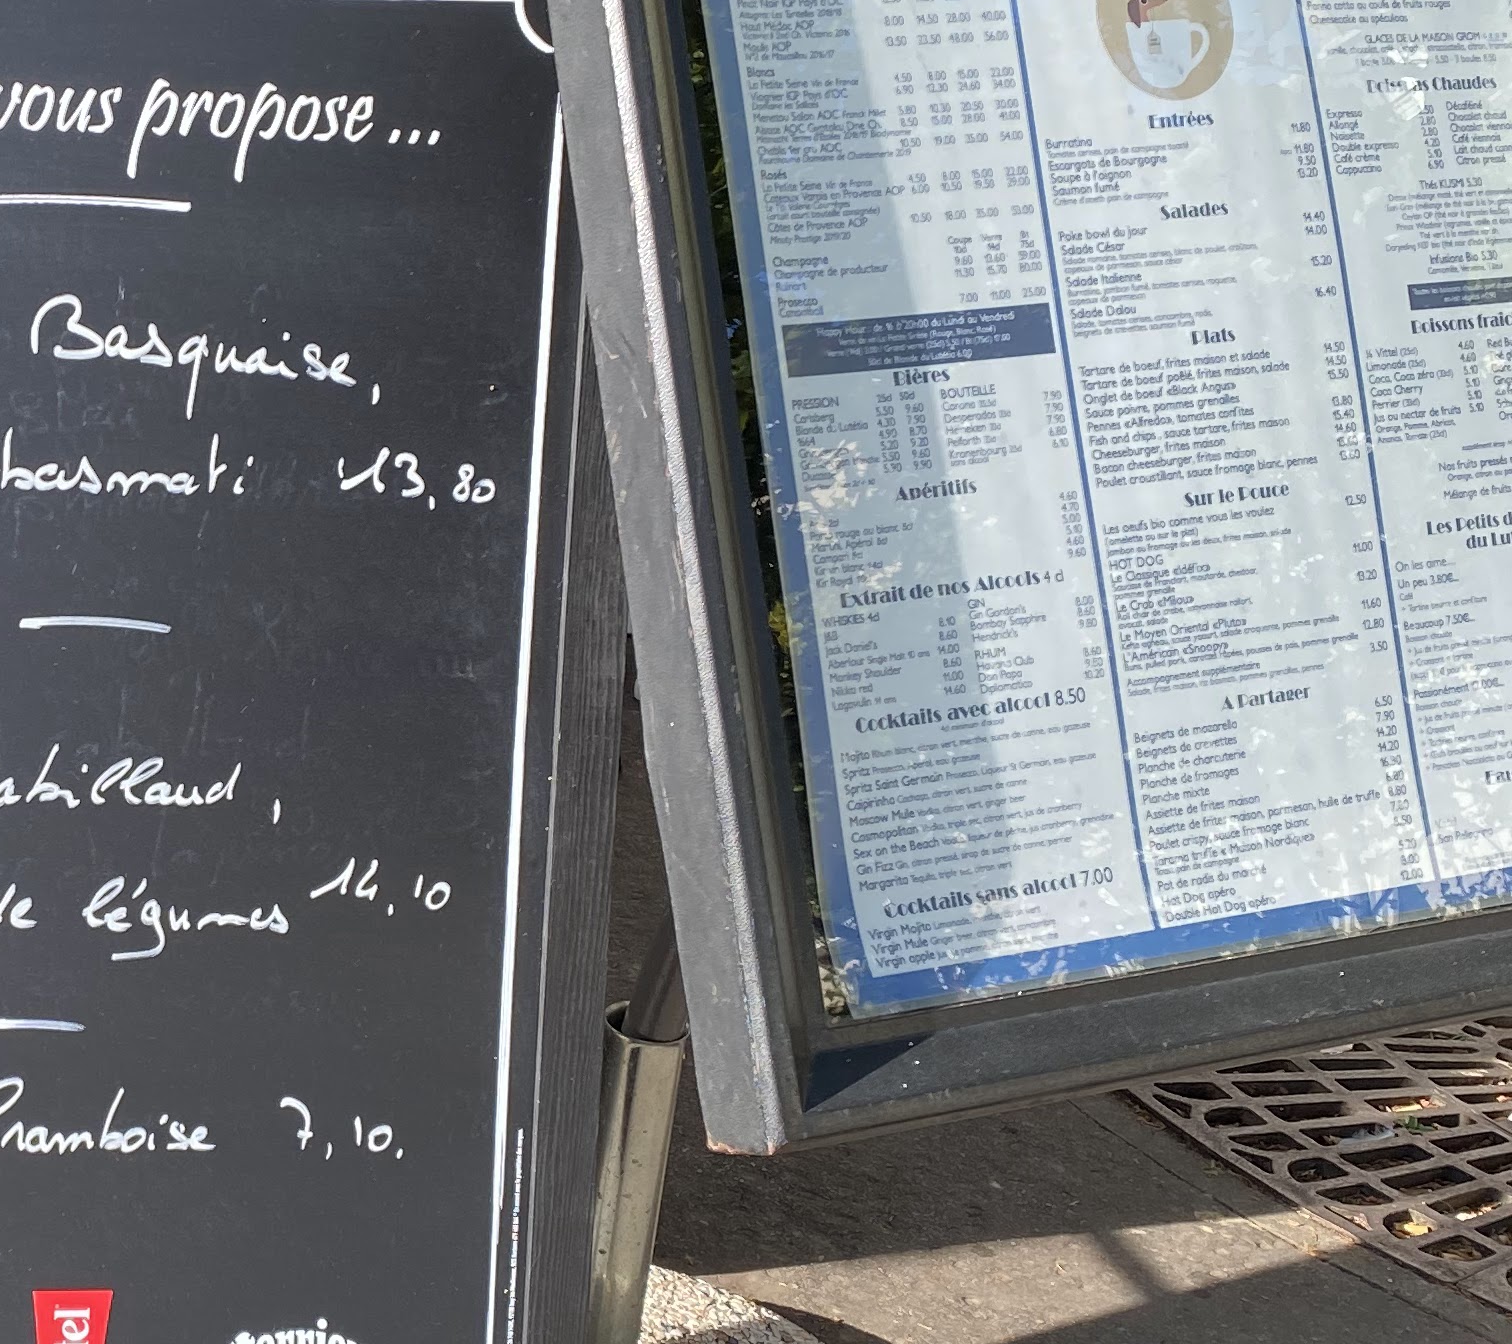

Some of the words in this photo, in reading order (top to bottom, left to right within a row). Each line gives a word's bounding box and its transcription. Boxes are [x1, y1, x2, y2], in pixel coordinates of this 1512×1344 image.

[1431, 74, 1496, 92] Chaudes
[1147, 109, 1214, 129] Entrées
[1047, 158, 1096, 172] Escargots
[1098, 157, 1110, 168] de
[1113, 153, 1167, 169] Bourgogne
[1050, 172, 1081, 184] Soupe
[1052, 184, 1092, 196] Saumon
[1159, 201, 1228, 220] Salades
[1085, 227, 1110, 239] bowl
[1126, 225, 1148, 239] jour
[1060, 243, 1093, 256] Salade
[1095, 240, 1124, 253] César
[1065, 275, 1098, 288] Salade
[1069, 306, 1103, 319] Salade
[1411, 314, 1474, 335] Boissons
[1477, 311, 1512, 328] fraic
[1190, 326, 1235, 345] Plats
[1078, 363, 1115, 377] Tartare
[1118, 362, 1131, 373] de
[1164, 356, 1190, 369] frites
[1193, 353, 1226, 365] maison
[1229, 352, 1239, 362] et
[1241, 348, 1270, 361] salade
[892, 365, 950, 386] Bières
[940, 383, 996, 400] BOUTEILLE
[1083, 391, 1118, 406] Onglet
[1120, 390, 1132, 401] de
[1134, 386, 1163, 400] boeuf
[1394, 382, 1423, 396] Cherry
[1164, 439, 1189, 453] frites
[1192, 436, 1225, 450] maison
[2, 428, 254, 497] basmati
[339, 447, 496, 510] 13,80
[894, 477, 977, 502] Apéritifs
[1184, 489, 1214, 507] Sur
[1218, 487, 1235, 503] le
[1238, 480, 1289, 501] Pouce
[1103, 523, 1119, 535] Les
[1150, 518, 1165, 529] bio
[1169, 514, 1203, 528] comme
[1206, 511, 1228, 523] vous
[1426, 517, 1452, 536] Les
[1454, 511, 1500, 532] Petits
[1465, 532, 1487, 550] du
[1108, 557, 1134, 571] HOT
[1136, 554, 1163, 567] DOG
[839, 585, 905, 609] Extrait
[909, 582, 934, 600] de
[937, 579, 970, 597] nos
[973, 568, 1040, 592] Alcools
[974, 646, 1006, 660] RHUM
[1220, 695, 1234, 711] A
[1236, 683, 1311, 709] Partager
[855, 705, 942, 735] Cocktails
[946, 700, 990, 721] avec
[994, 690, 1050, 714] alcool
[1054, 686, 1086, 707] 8.50
[1134, 728, 1174, 745] Beignets
[1177, 725, 1189, 737] de
[1140, 775, 1177, 791] Planche
[1180, 772, 1192, 784] de
[1195, 765, 1239, 783] fromages
[891, 807, 915, 821] Mule
[883, 889, 970, 920] Cocktails
[975, 882, 1018, 906] sans
[1022, 871, 1076, 896] alcool
[1080, 865, 1113, 887] 7.00
[1183, 890, 1205, 906] Dog
[83, 877, 289, 961] légumes
[311, 859, 451, 916] 14,10
[868, 925, 897, 942] Virgin
